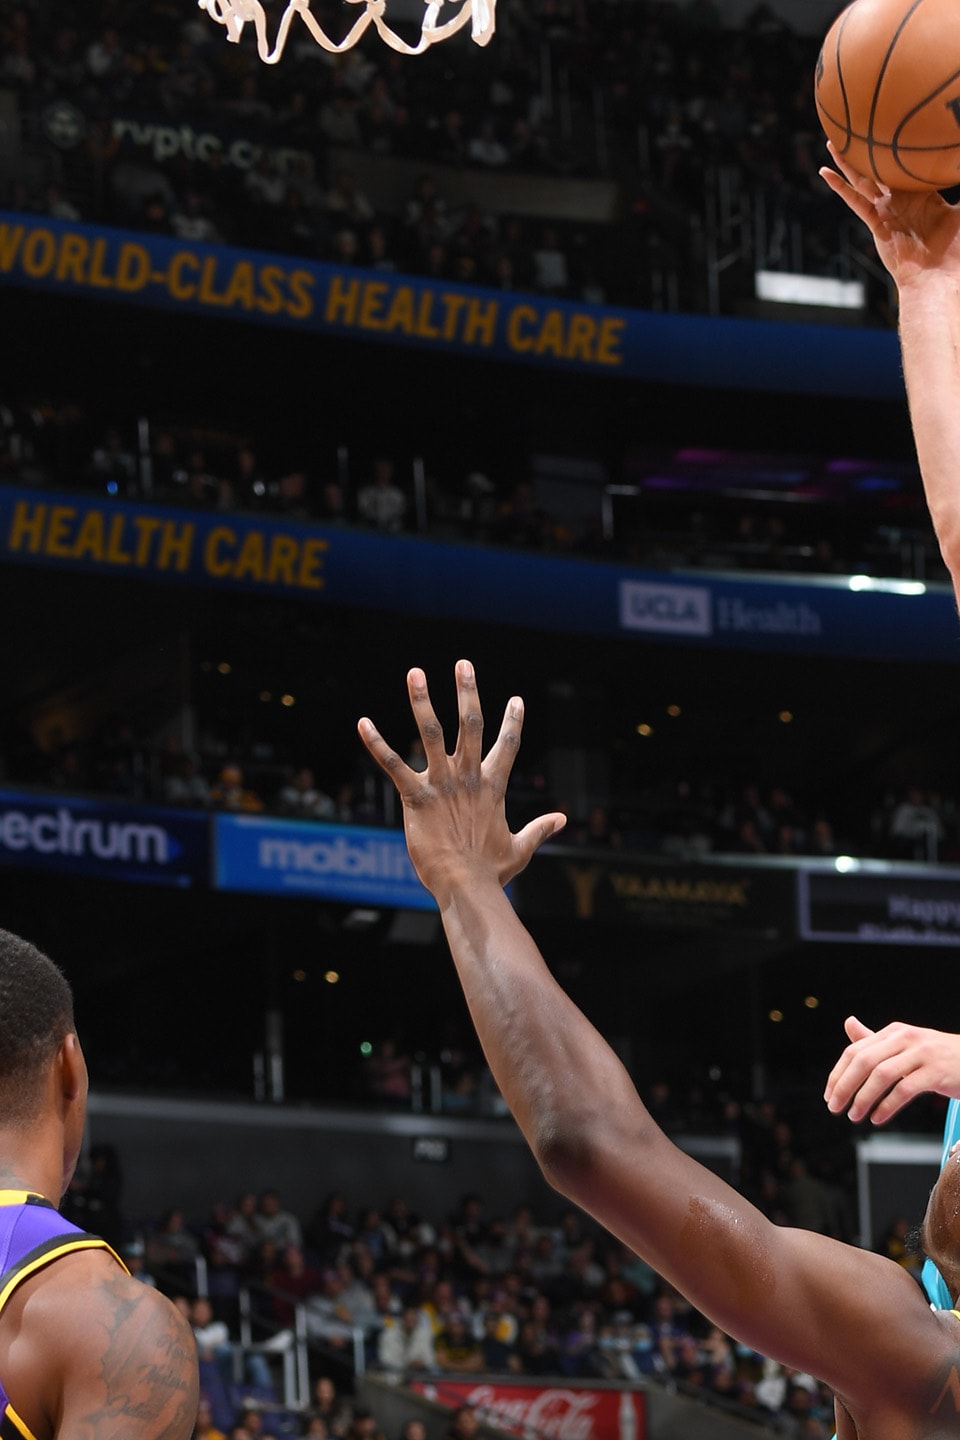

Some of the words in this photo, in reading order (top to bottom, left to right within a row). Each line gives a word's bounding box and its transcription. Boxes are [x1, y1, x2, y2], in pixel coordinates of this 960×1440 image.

[323, 276, 498, 347] HEALTH
[507, 303, 627, 366] CARE
[9, 502, 194, 570] HEALTH
[205, 525, 328, 587] CARE
[629, 592, 698, 620] UCLA
[716, 596, 822, 637] Health
